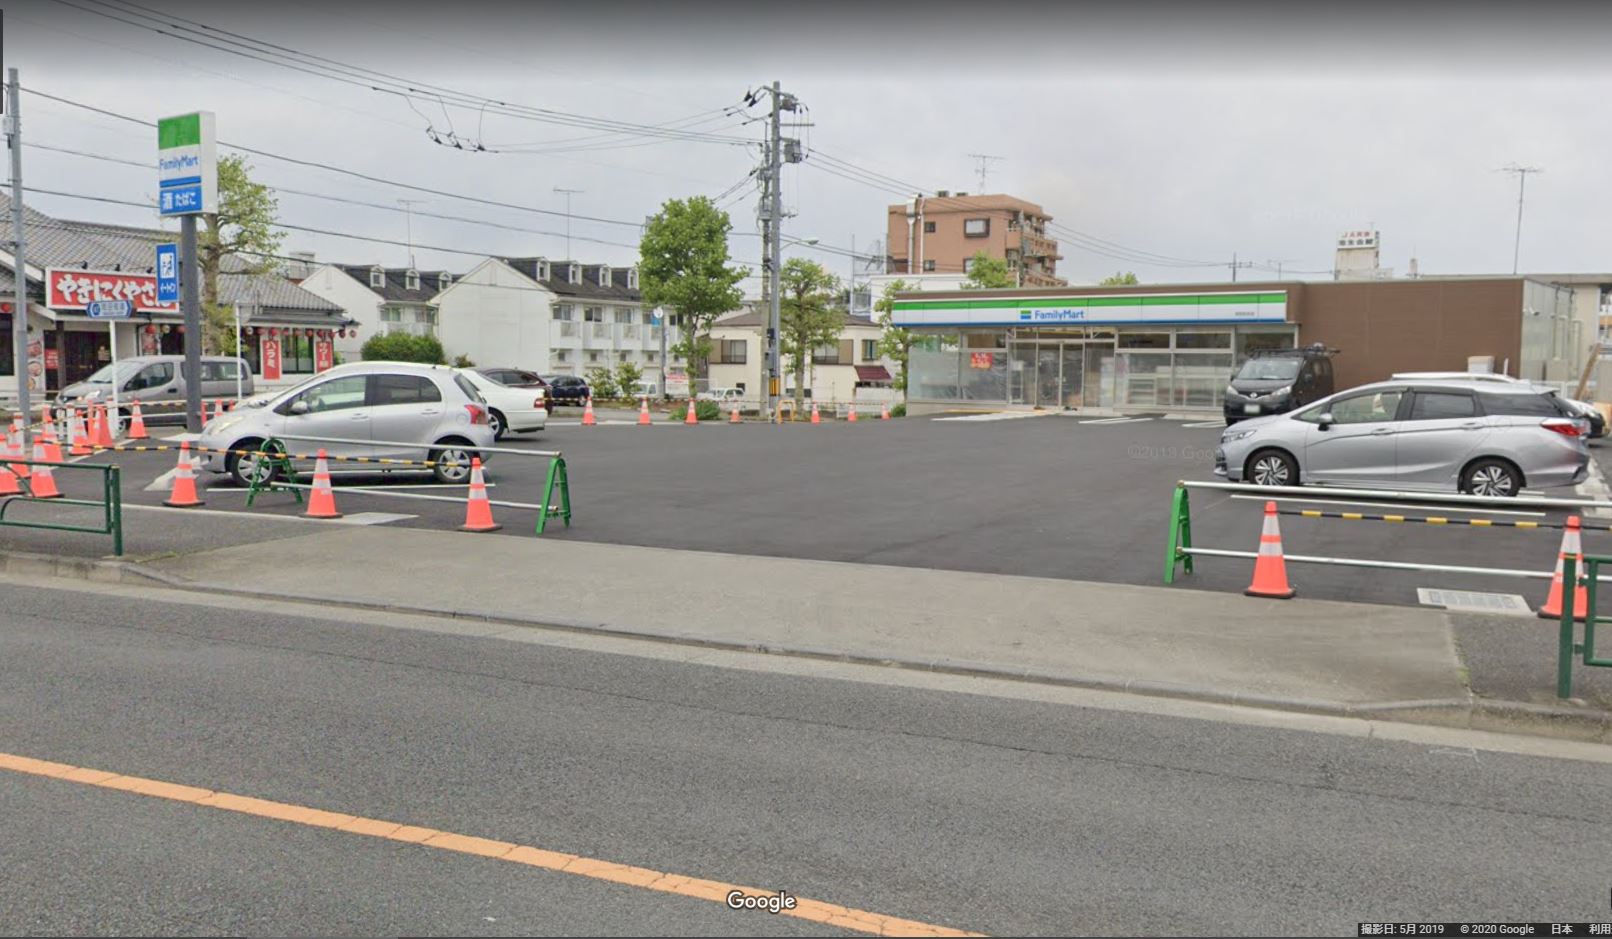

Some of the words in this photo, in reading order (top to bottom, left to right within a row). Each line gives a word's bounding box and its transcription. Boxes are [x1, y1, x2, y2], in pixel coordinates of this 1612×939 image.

[160, 155, 199, 171] FamilyMart
[174, 191, 197, 208] たばこ
[1034, 309, 1085, 321] FamilyMart
[265, 341, 277, 369] ハラミ
